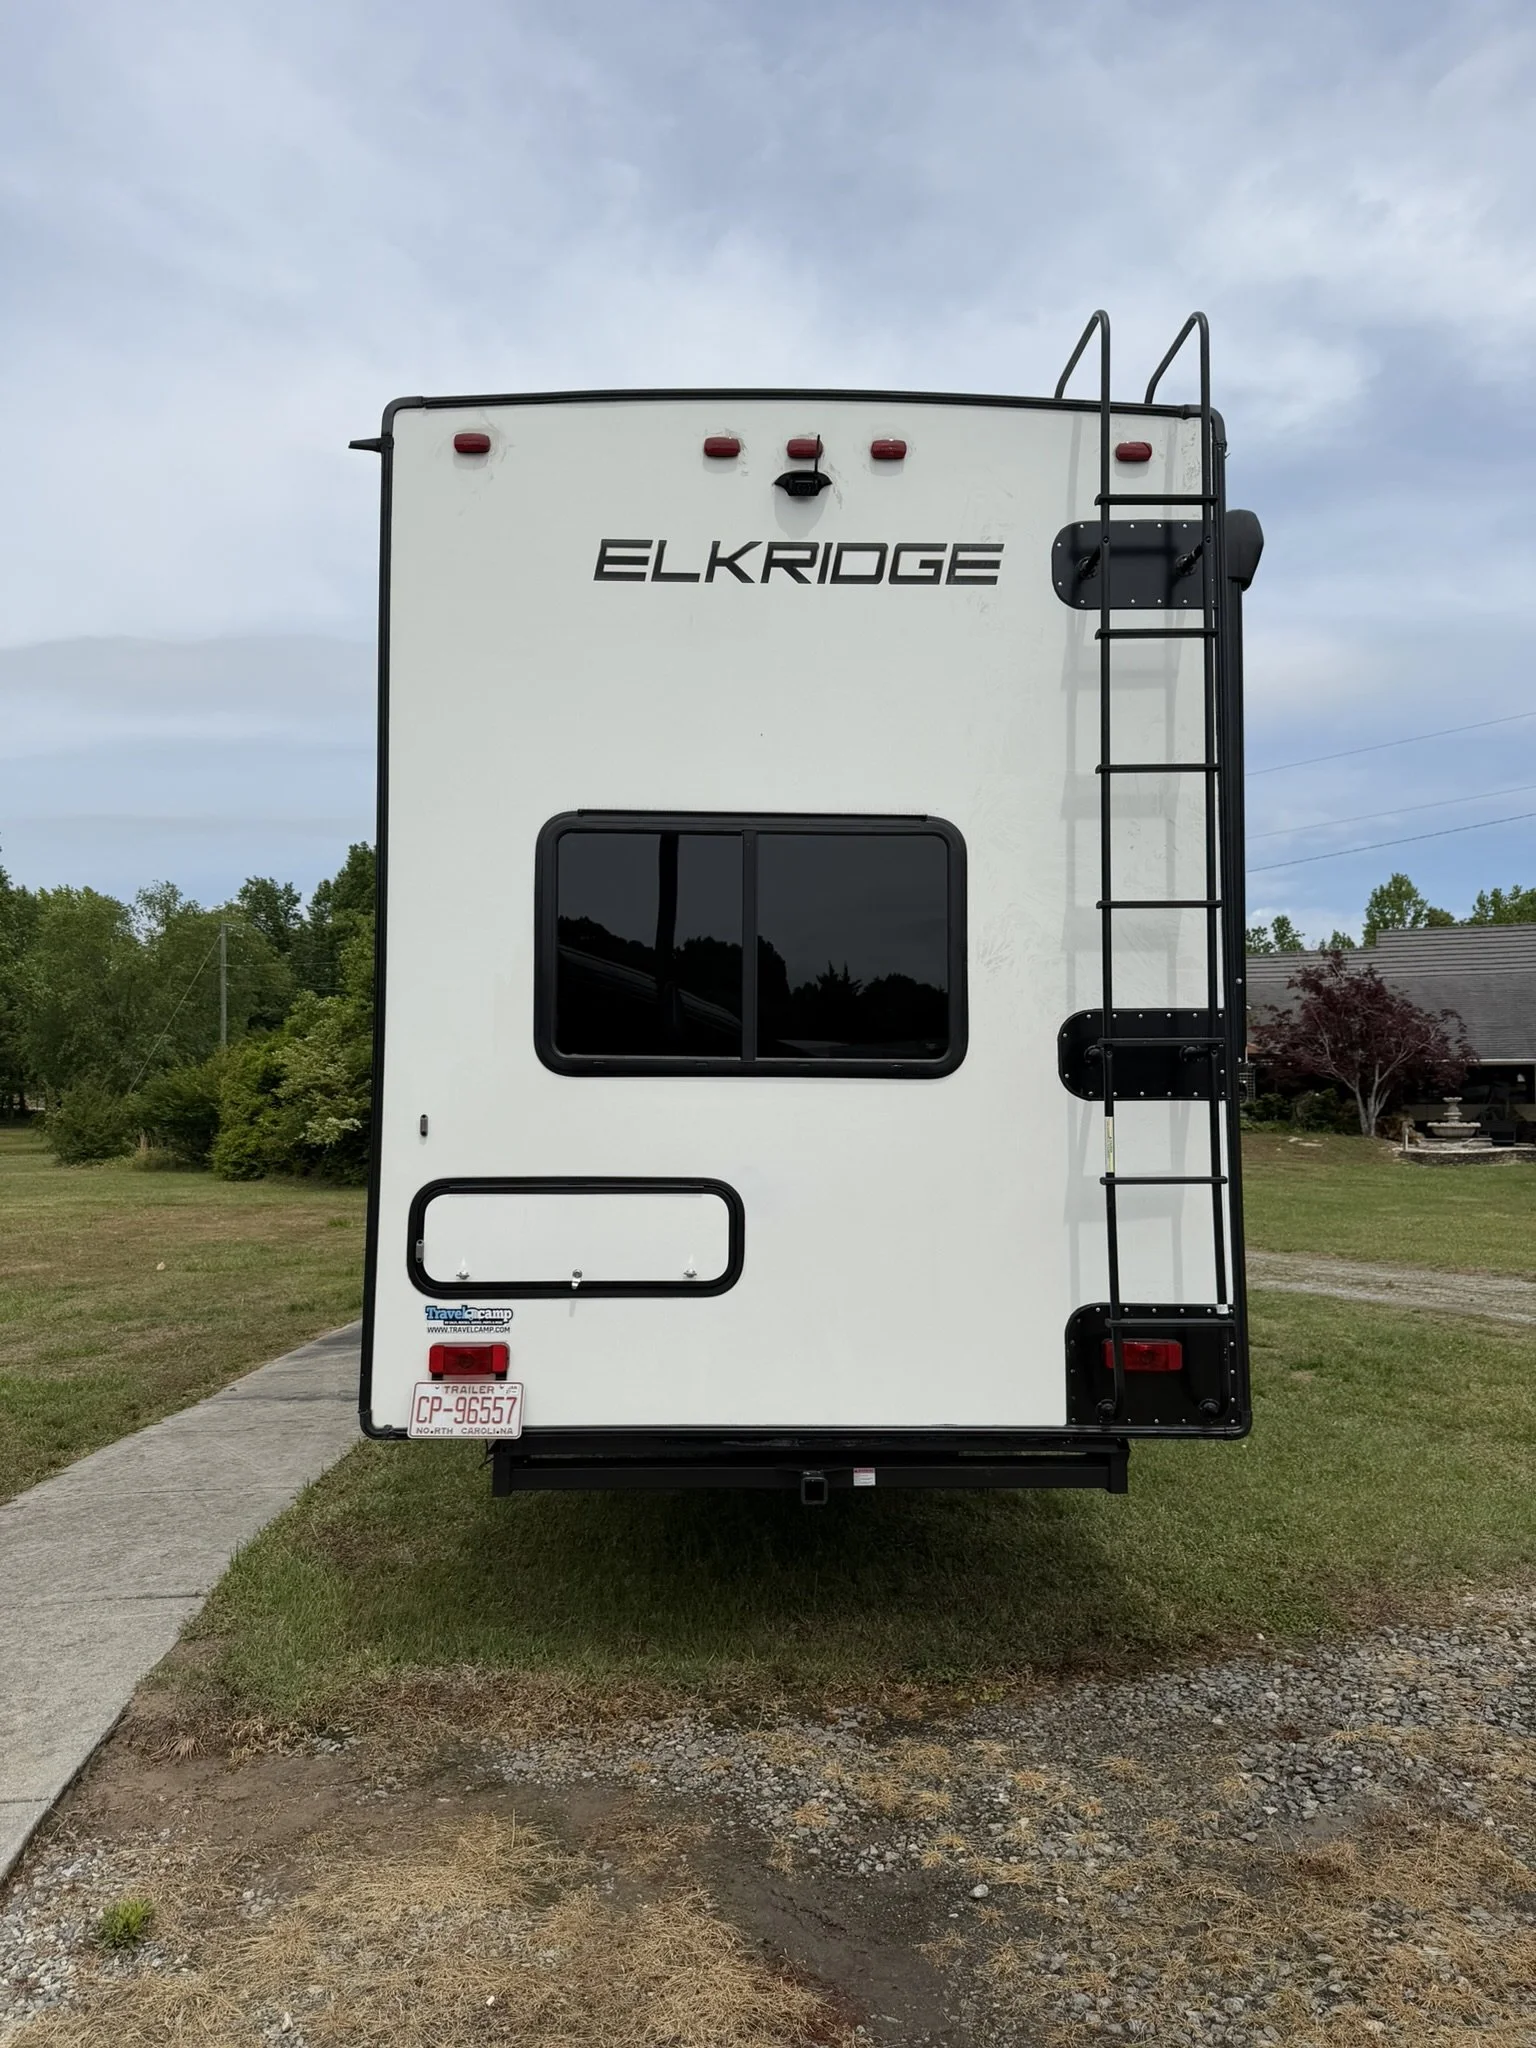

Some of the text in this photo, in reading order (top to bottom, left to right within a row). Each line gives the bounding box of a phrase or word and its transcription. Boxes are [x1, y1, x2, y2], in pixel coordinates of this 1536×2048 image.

[593, 538, 1005, 586] ELKRIDGE
[427, 1326, 511, 1334] WWW.TRAVELCAMP.COM
[444, 1385, 495, 1394] TRAILER
[416, 1396, 518, 1425] CP-96557
[416, 1427, 513, 1435] NORTH CAROLINA
